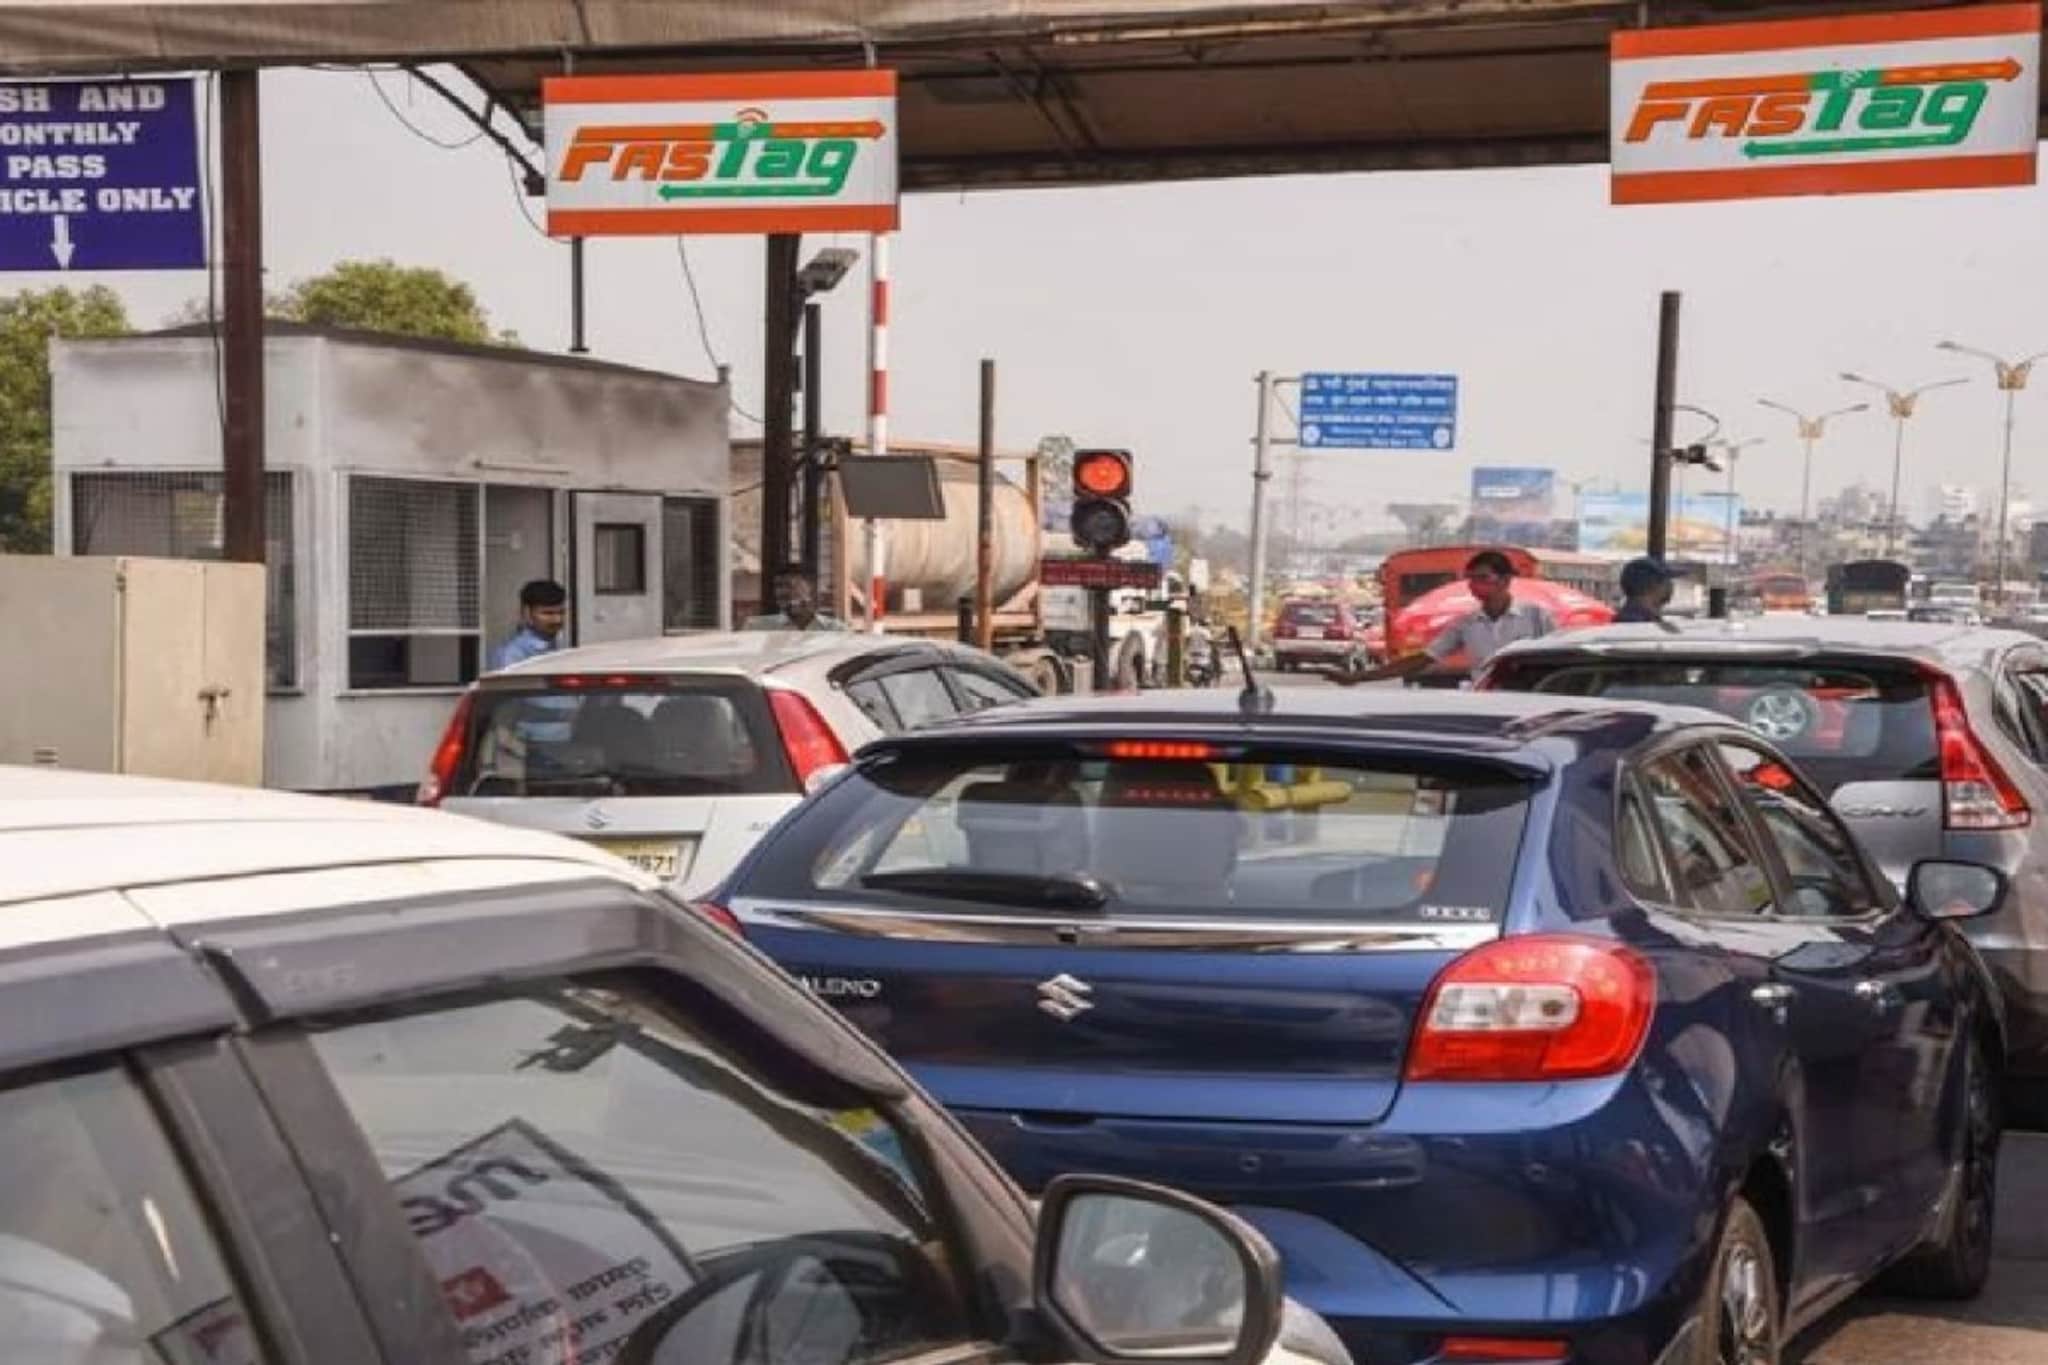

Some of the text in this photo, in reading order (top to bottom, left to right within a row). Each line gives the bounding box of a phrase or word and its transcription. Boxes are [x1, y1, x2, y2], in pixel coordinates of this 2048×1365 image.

[79, 86, 165, 112] AND
[0, 122, 141, 146] ONTHLY
[8, 154, 106, 179] PASS
[96, 187, 195, 212] ONLY
[792, 976, 881, 997] ALENO
